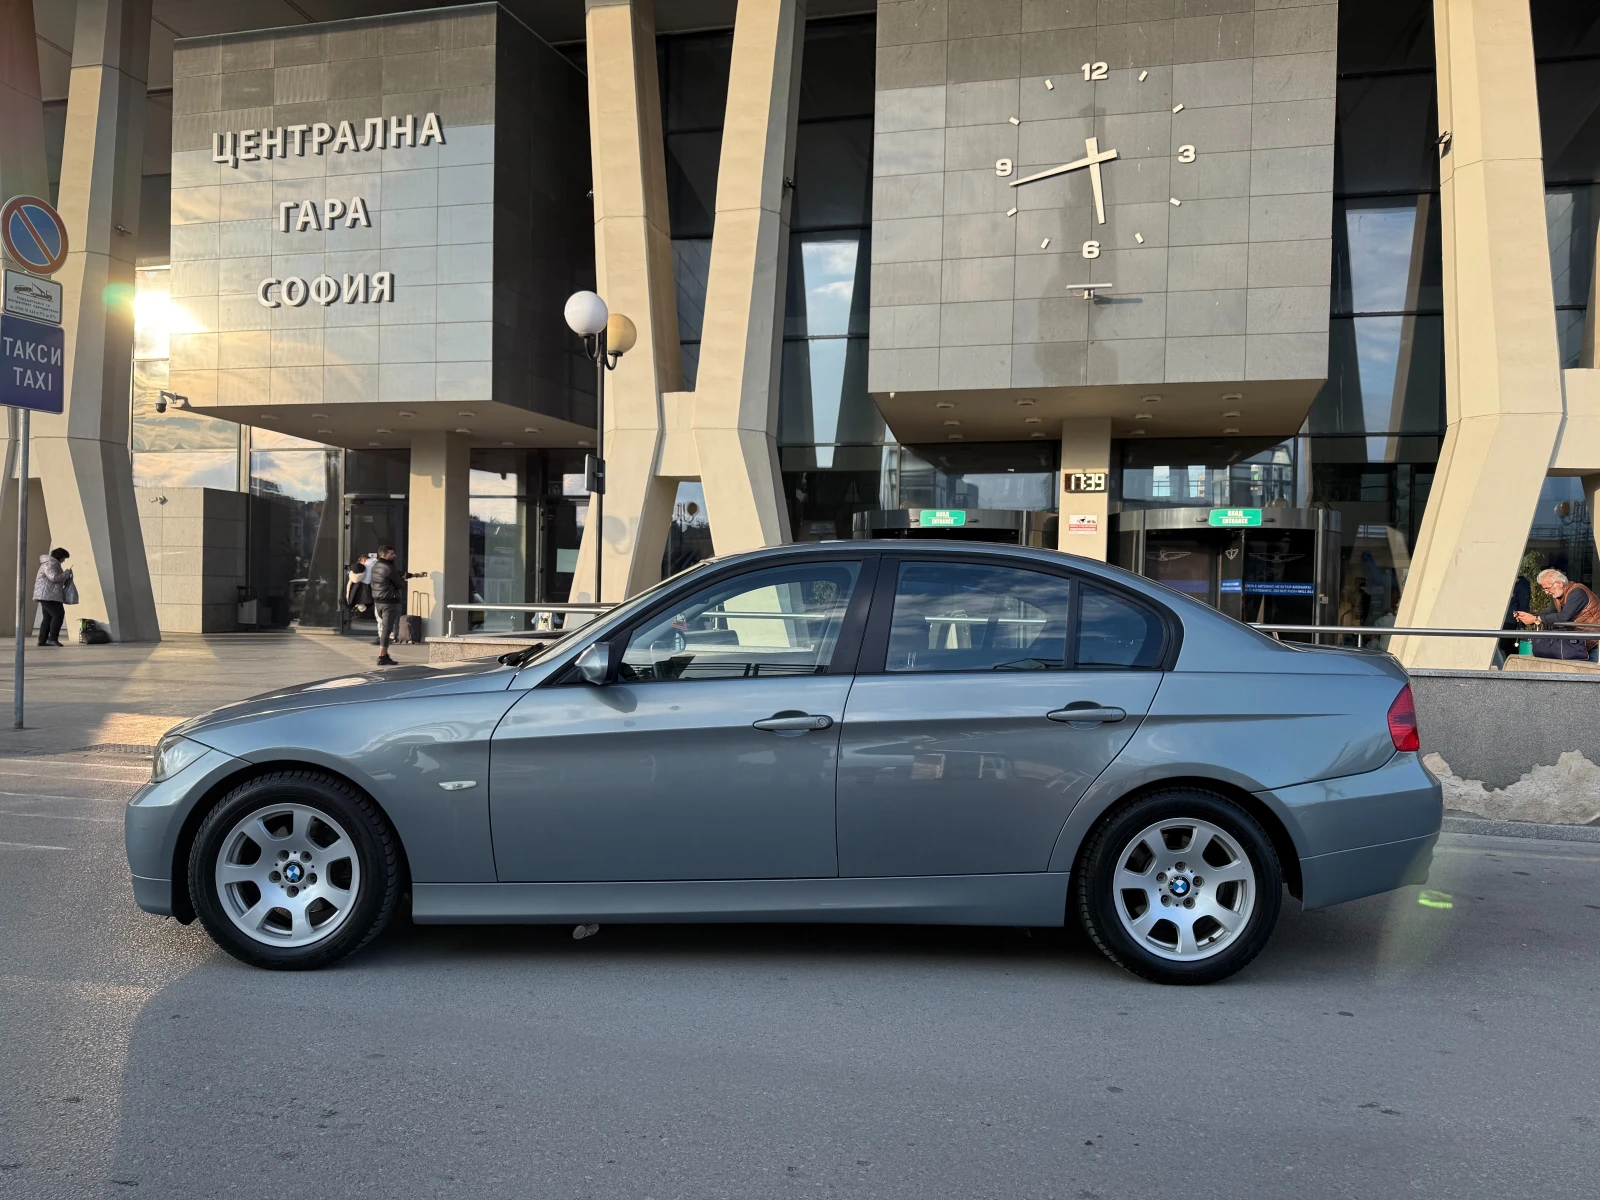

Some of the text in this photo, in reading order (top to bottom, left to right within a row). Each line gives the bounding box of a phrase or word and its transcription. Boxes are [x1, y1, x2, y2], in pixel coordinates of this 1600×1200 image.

[1081, 61, 1109, 81] 12
[212, 112, 446, 168] ЦЕНТРАЛНА
[1177, 144, 1196, 163] 3
[995, 158, 1013, 177] 9
[279, 196, 372, 233] ГАРА
[1082, 240, 1100, 259] 6
[257, 271, 395, 309] СОФИЯ
[3, 336, 61, 366] ТАКСИ
[13, 366, 52, 392] TAXI
